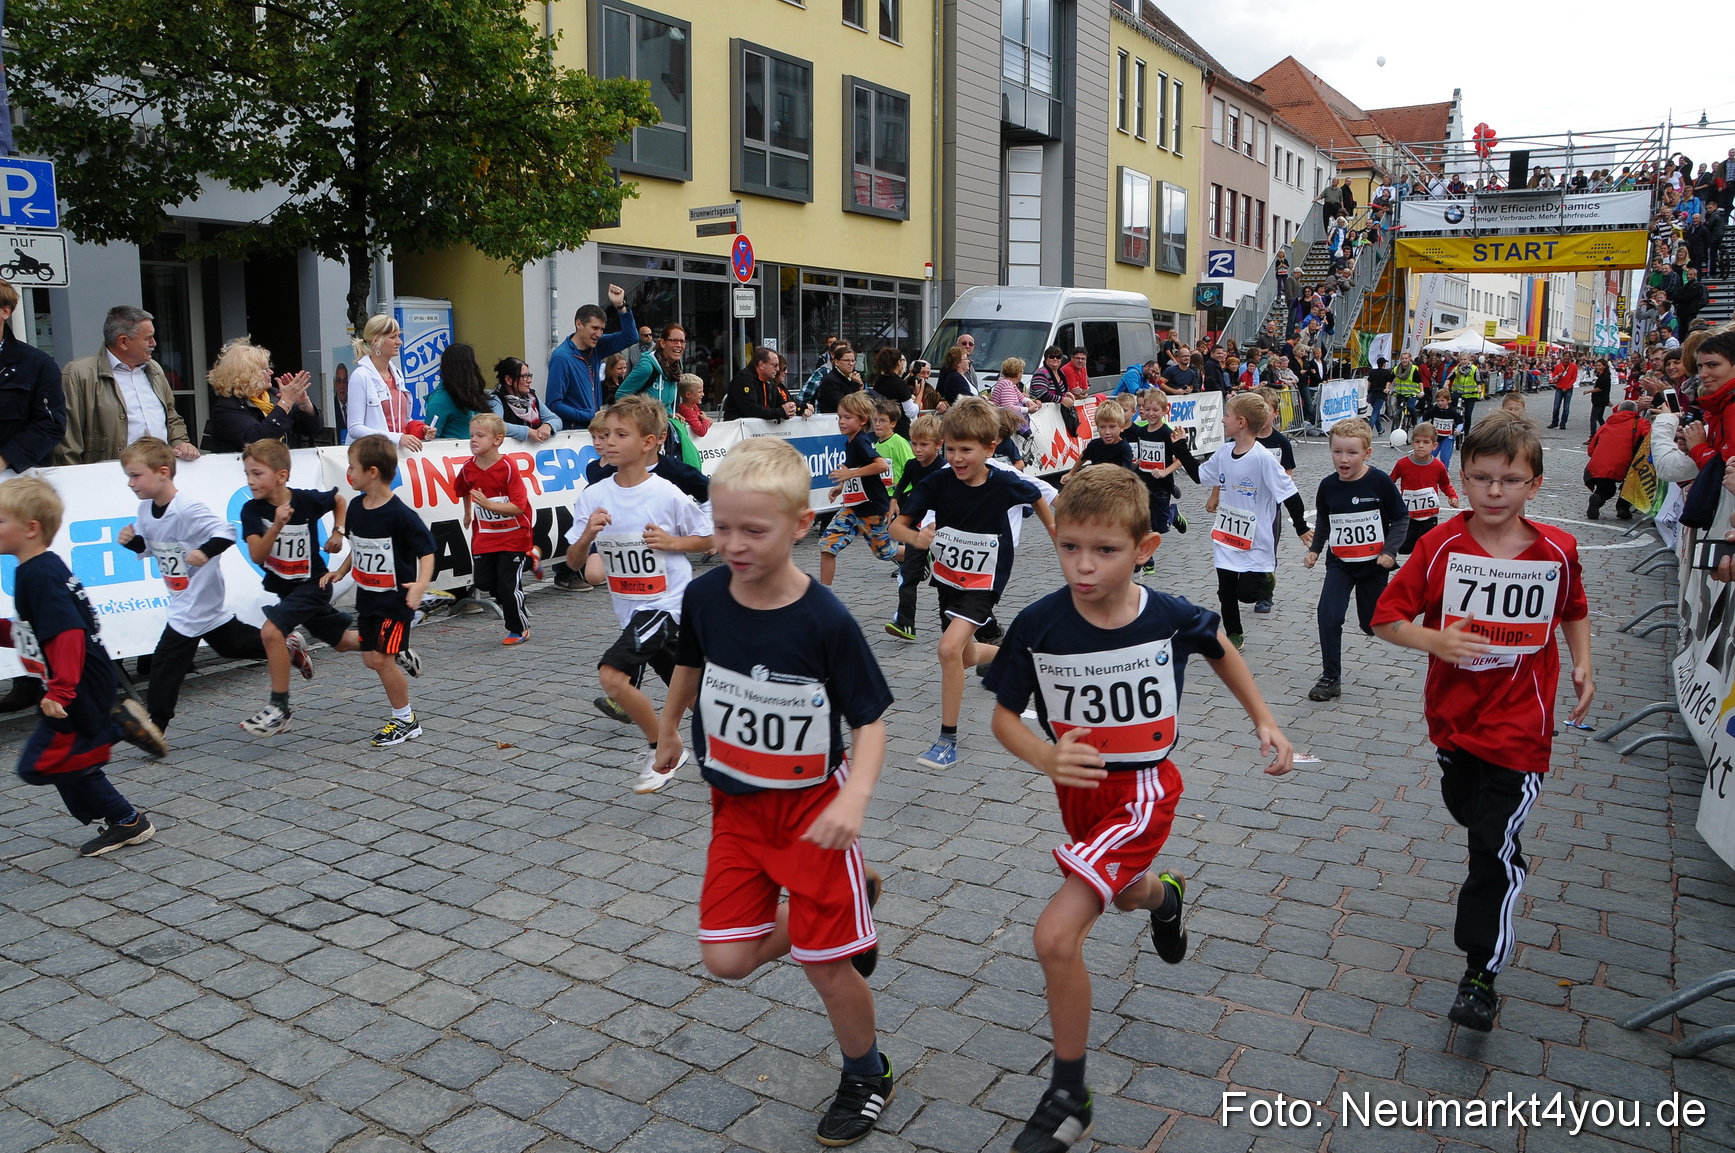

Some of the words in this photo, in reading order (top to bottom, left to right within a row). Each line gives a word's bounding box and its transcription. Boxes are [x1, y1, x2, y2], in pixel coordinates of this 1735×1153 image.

[0, 167, 37, 217] P
[690, 207, 735, 219] Brunnwirtsgasse
[1469, 205, 1498, 215] BMW
[1500, 201, 1600, 213] EfficientDynamics
[1500, 214, 1537, 222] Verbrauch.
[1558, 211, 1601, 219] Fahrfreude.
[10, 237, 36, 248] nur
[1472, 241, 1559, 262] START
[1415, 319, 1425, 341] Audi
[407, 445, 601, 508] INTRSPO
[844, 478, 859, 493] 96
[1404, 496, 1436, 510] 7175
[1220, 514, 1250, 537] 7117
[1345, 516, 1372, 524] Neumarkt
[615, 539, 648, 548] Neumark
[953, 536, 988, 547] Neumarkt
[1335, 524, 1377, 545] 7303
[603, 548, 656, 574] 7106
[935, 541, 990, 572] 7367
[1449, 562, 1487, 576] PARTL
[1488, 568, 1542, 580] Neumarkt
[620, 580, 646, 592] Moritz
[1458, 578, 1545, 618] 7100
[1470, 623, 1523, 646] Philipp
[1039, 663, 1082, 677] PARTL
[1085, 657, 1151, 676] Neumarkt
[705, 676, 743, 698] PARTL
[743, 689, 808, 708] Neumarkt
[1054, 676, 1162, 724] 7306
[713, 699, 814, 752] 7307
